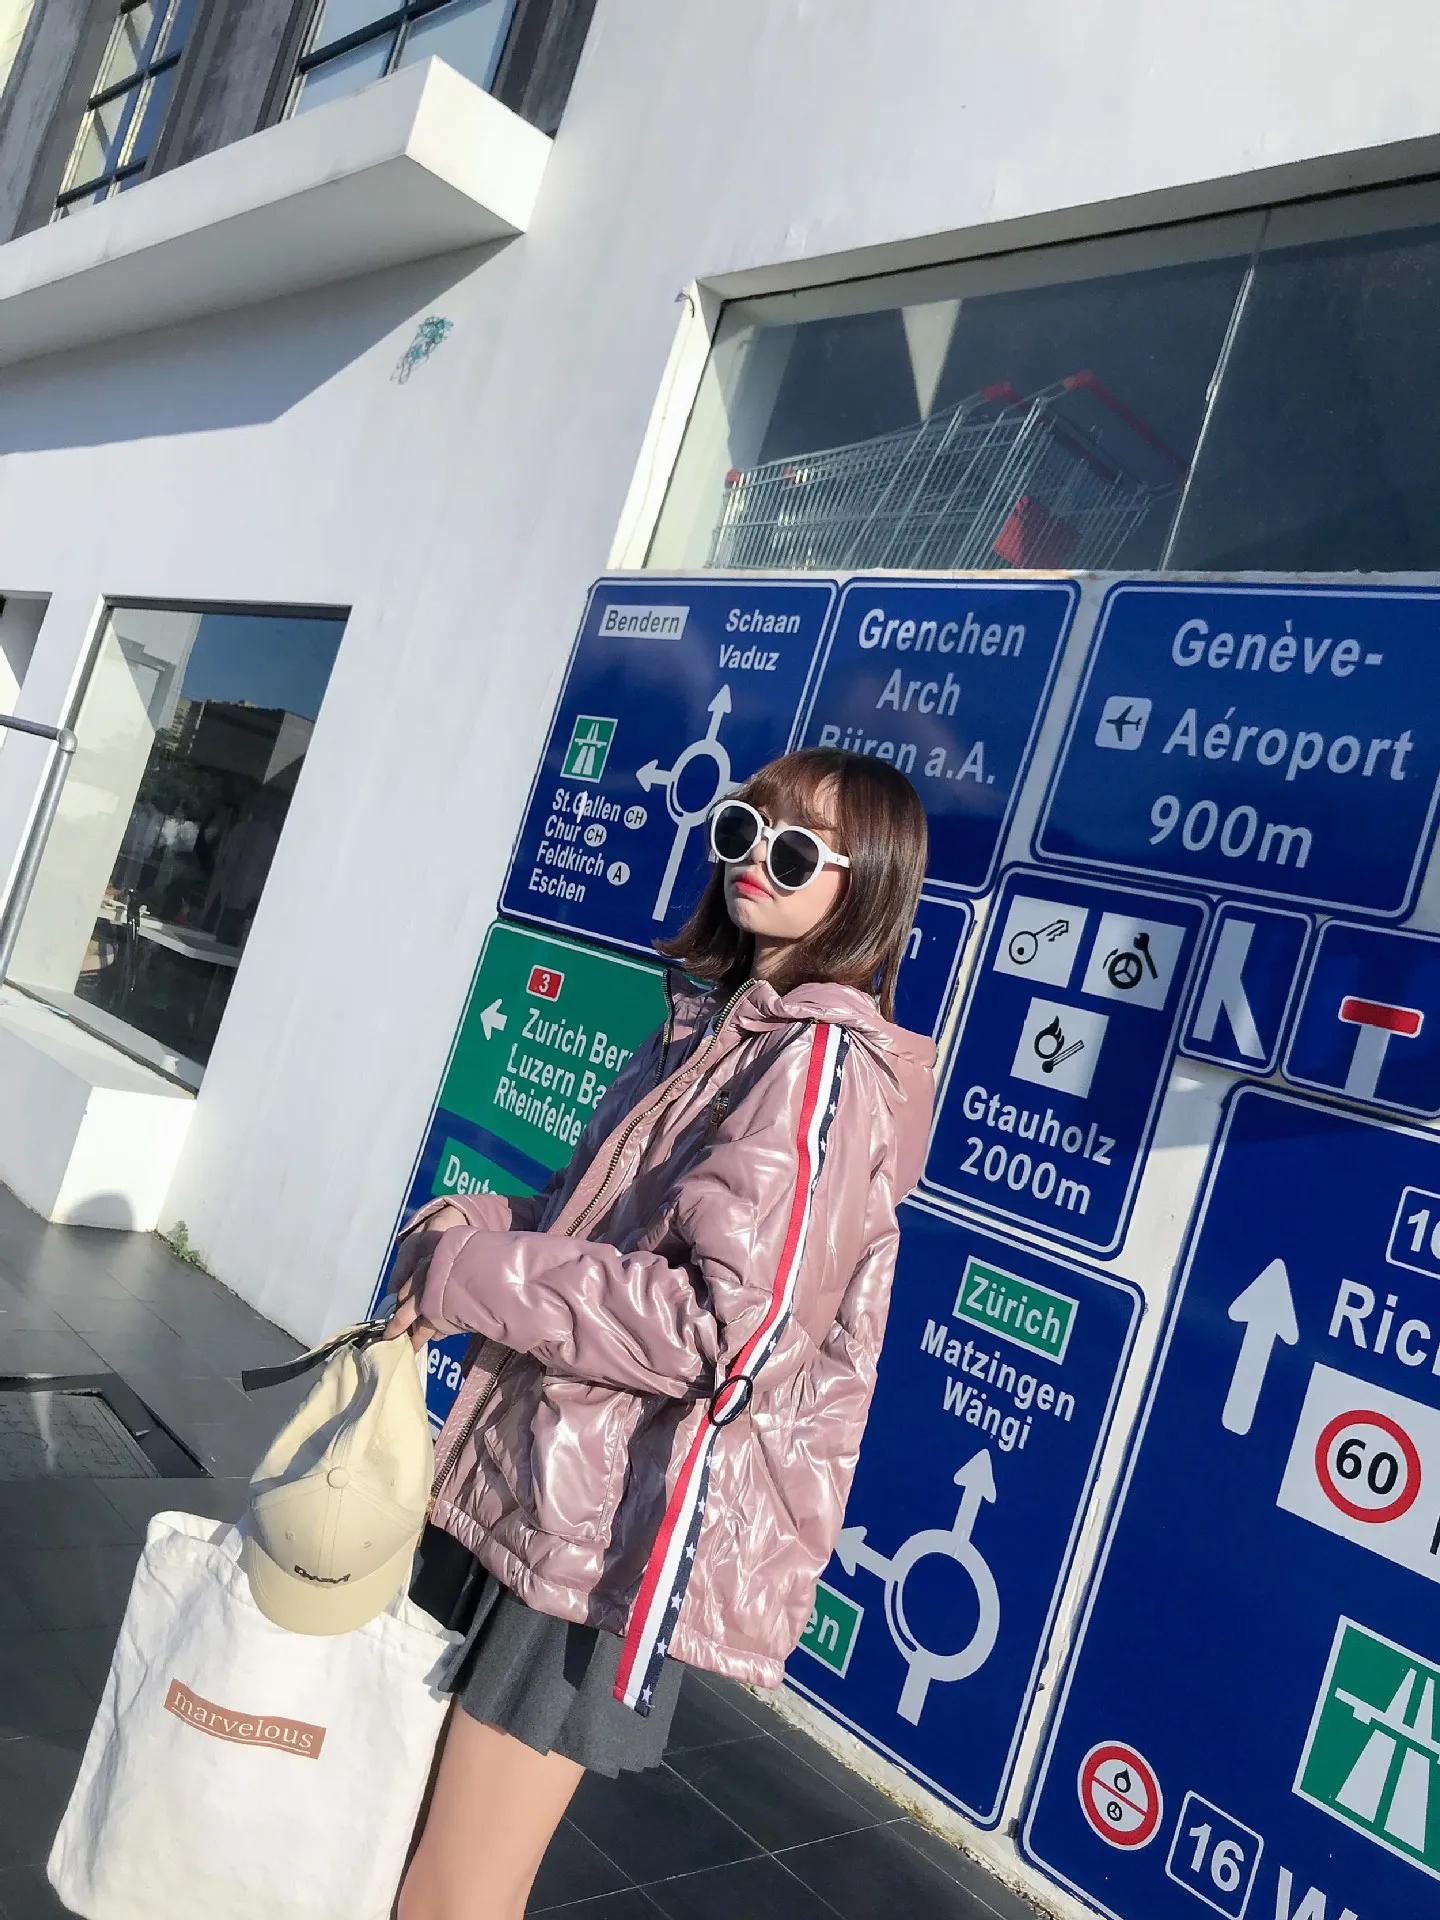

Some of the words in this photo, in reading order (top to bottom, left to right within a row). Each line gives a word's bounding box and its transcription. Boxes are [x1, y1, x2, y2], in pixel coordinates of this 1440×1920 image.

[604, 610, 681, 634] Bendern
[725, 608, 801, 634] Schaan
[858, 608, 1026, 657] Grenchen
[1171, 618, 1384, 678] Genève-
[718, 644, 780, 671] Vaduz
[876, 668, 962, 716] Arch
[924, 741, 996, 785] a.A.
[1162, 706, 1415, 782] Aéroport
[545, 815, 581, 842] Chur
[586, 828, 604, 843] CH
[625, 810, 645, 825] CH
[1149, 794, 1313, 868] 900m
[528, 867, 586, 903] Eschen
[536, 840, 605, 877] Feldkirch
[538, 973, 551, 993] 3
[521, 1007, 587, 1058] Zurich
[588, 1031, 634, 1072] Ber
[506, 1042, 576, 1098] Luzern
[493, 1075, 588, 1147] Rheinfelde
[959, 1136, 1092, 1216] 2000m
[964, 1275, 1063, 1345] Zürich
[1328, 1277, 1440, 1377] Ric
[920, 1320, 1076, 1422] Matzingen
[942, 1376, 1032, 1452] Wängi
[1335, 1438, 1400, 1496] 60
[173, 1690, 315, 1749] marvelous
[1188, 1822, 1246, 1893] 16
